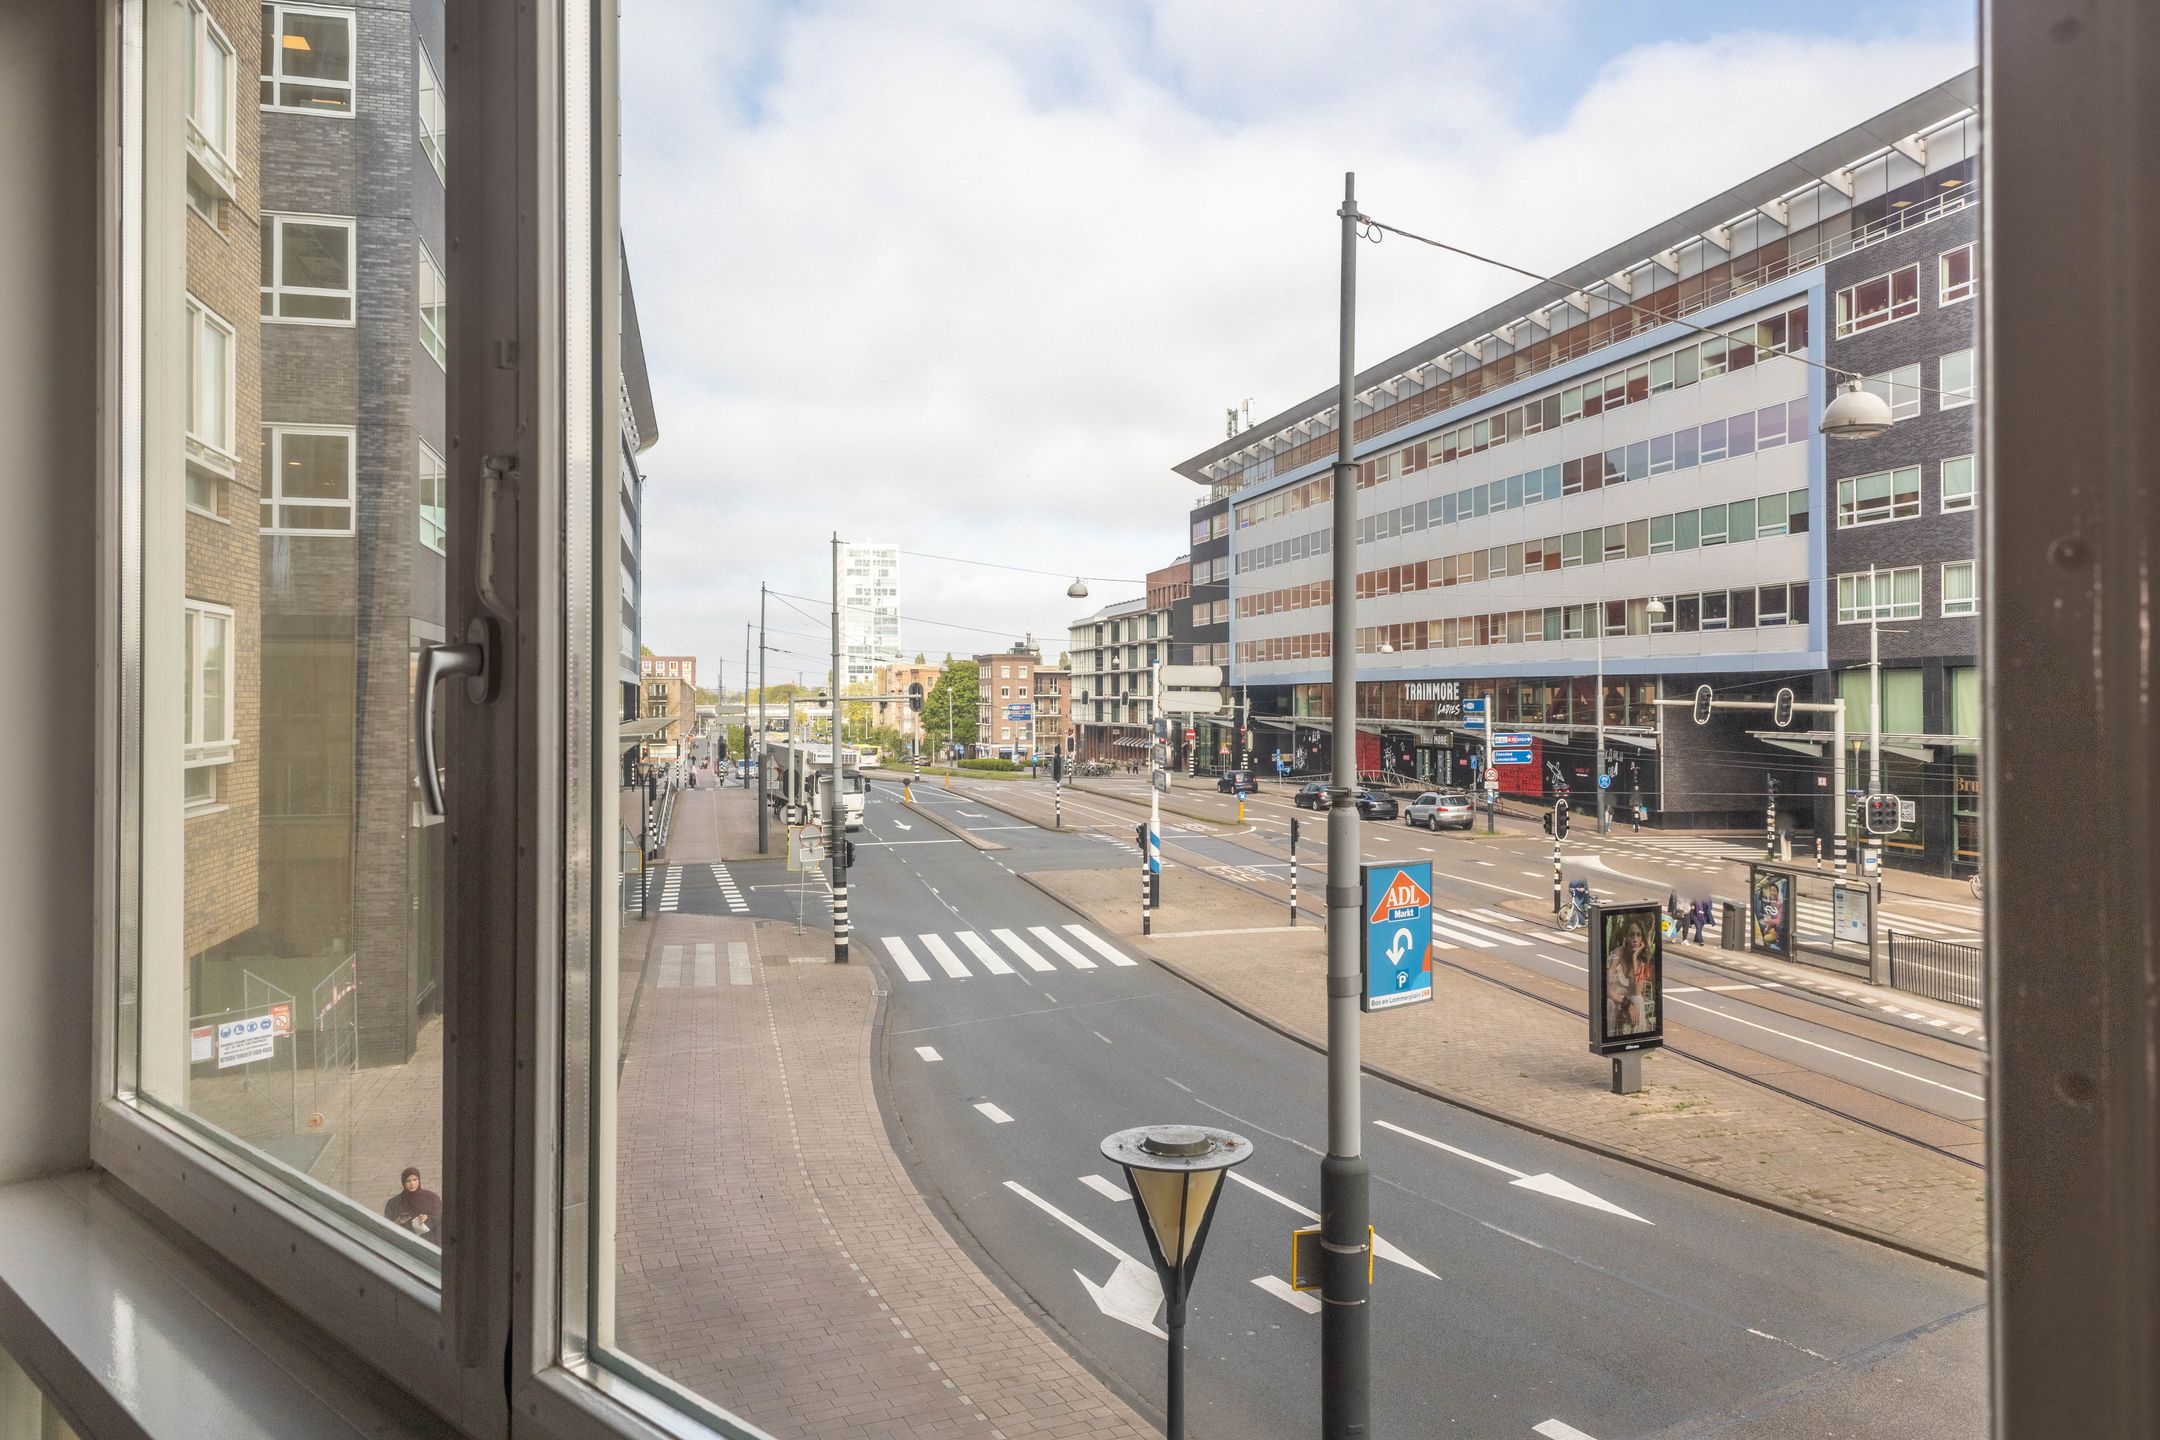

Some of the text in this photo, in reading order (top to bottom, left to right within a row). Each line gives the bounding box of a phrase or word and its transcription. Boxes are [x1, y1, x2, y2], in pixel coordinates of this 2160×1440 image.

[1405, 682, 1459, 700] TRAINMORE
[1437, 703, 1461, 715] LADIES
[1386, 885, 1420, 907] ADL
[1394, 908, 1414, 919] Markt
